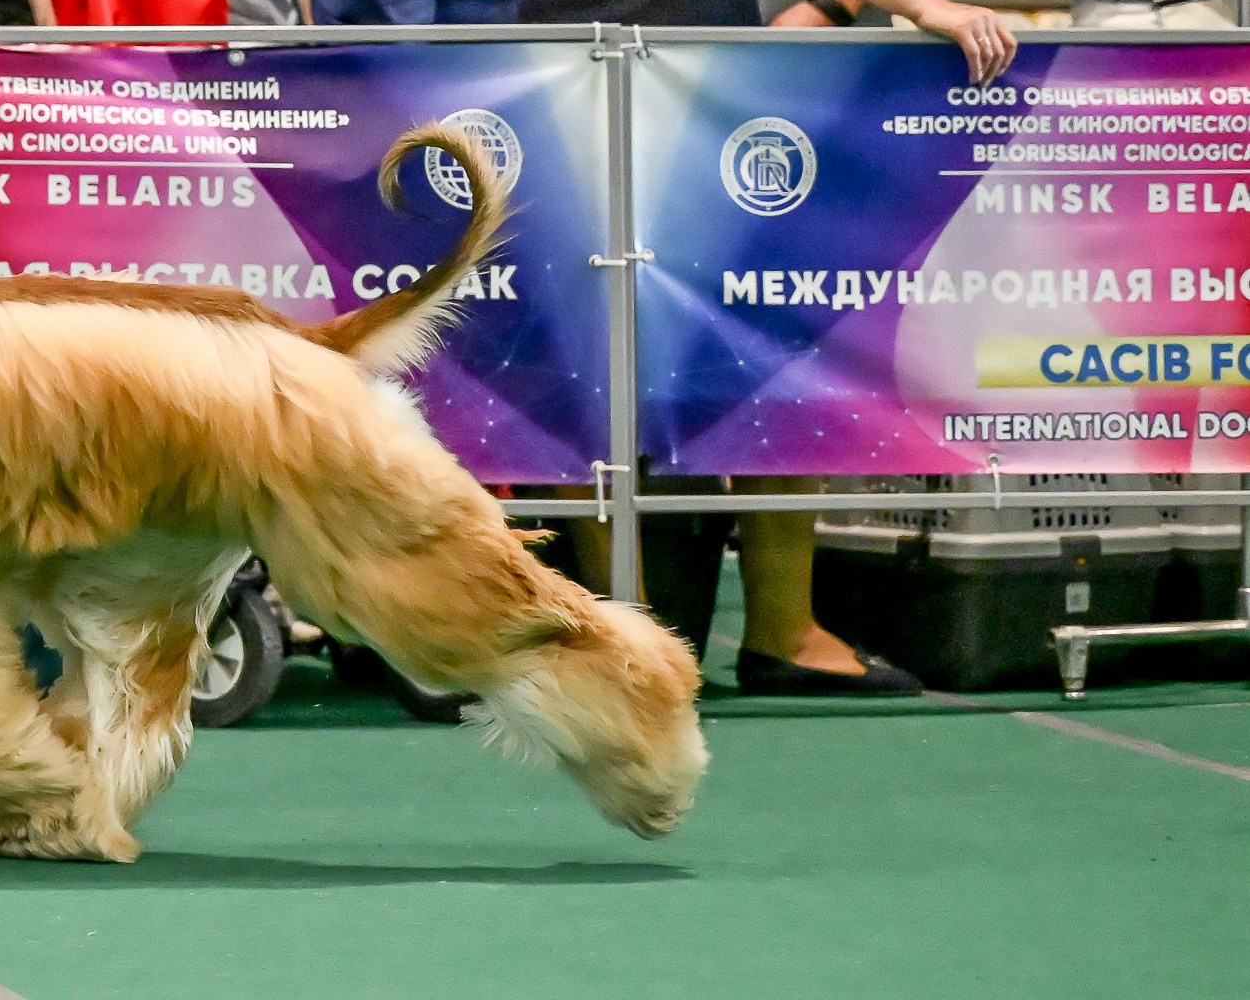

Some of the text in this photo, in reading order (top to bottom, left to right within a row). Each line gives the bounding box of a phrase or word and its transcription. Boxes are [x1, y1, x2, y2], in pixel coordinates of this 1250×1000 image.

[112, 77, 280, 102] ОБЪЕДИНЕНИЙ
[947, 86, 1017, 106] СОЮЗ
[1023, 86, 1203, 107] ОБЩЕСТВЕННЫХ
[172, 109, 350, 131] ОБЪЕДИНЕНИЕ»
[882, 114, 1250, 135] «БЕЛОРУССКОЕ КИНОЛОГИЧЕСКО
[21, 132, 178, 154] CINOLOGICAL
[184, 135, 257, 155] UNION
[973, 143, 1117, 163] BELORUSSIAN
[48, 173, 255, 207] BELARUS
[975, 183, 1114, 213] MINSK
[352, 263, 517, 300] СОАК
[723, 268, 1153, 310] МЕЖДУНАРОДНАЯ
[1040, 343, 1191, 383] CACIB
[944, 410, 1250, 442] INTERNATIONAL DO
